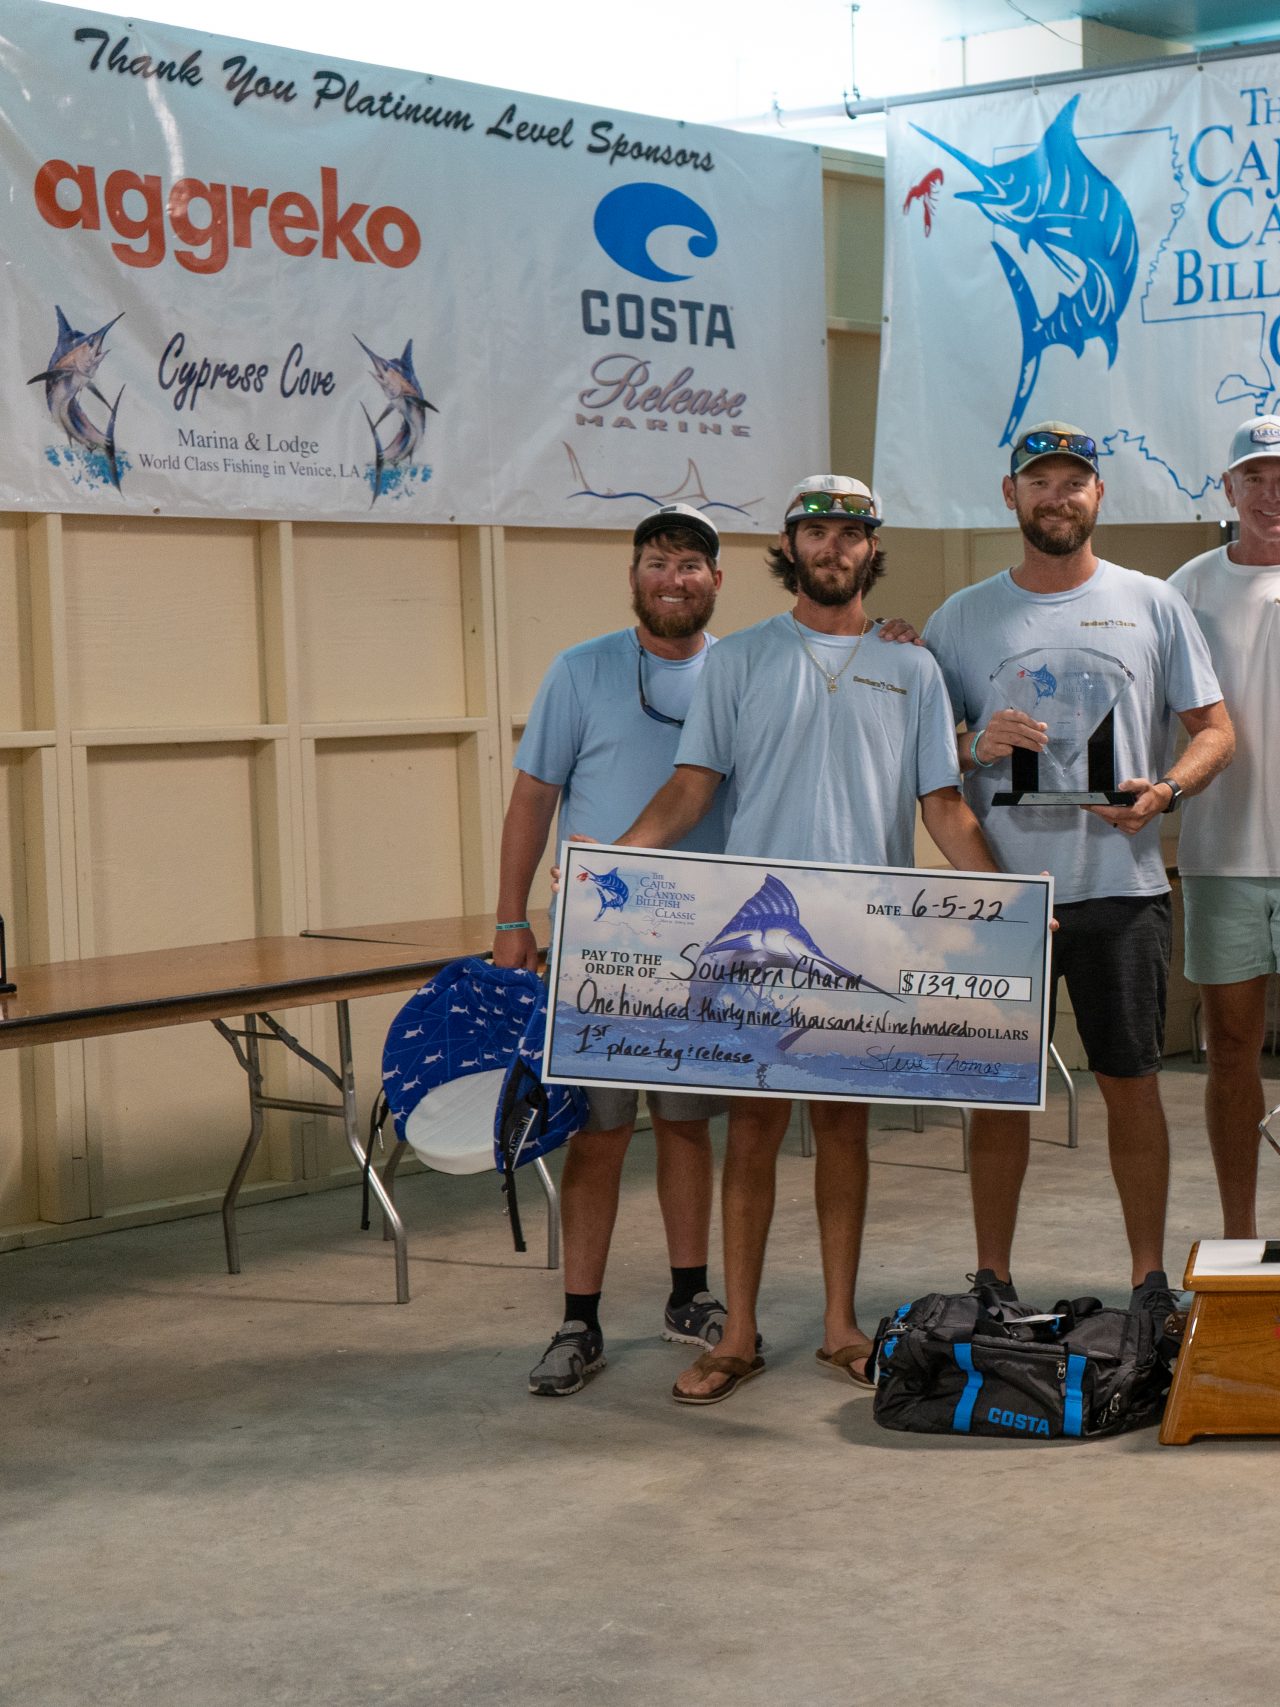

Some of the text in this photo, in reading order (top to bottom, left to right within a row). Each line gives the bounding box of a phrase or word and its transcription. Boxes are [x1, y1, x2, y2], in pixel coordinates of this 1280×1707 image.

[74, 27, 715, 172] Thank You Platinum Level Sponsors
[33, 158, 422, 275] aggreko
[581, 289, 736, 350] COSTA
[158, 332, 335, 411] Cypress Cove
[578, 353, 747, 418] Release
[576, 413, 752, 437] MARINE
[178, 429, 319, 458] Marina & Lodge
[139, 453, 360, 479] World Class Fishing in Venice, LA
[640, 877, 676, 890] CAJUN
[644, 888, 695, 901] CANYONS
[636, 895, 681, 908] BILLFISH
[655, 908, 696, 920] CLASSIC
[867, 904, 901, 916] DATE
[912, 889, 1004, 922] 6-5-22
[581, 949, 662, 965] PAY TO THE
[585, 963, 656, 978] ORDER OF
[670, 943, 863, 991] Southern Charm
[577, 978, 614, 1014] One
[619, 983, 690, 1020] hundred
[786, 1005, 864, 1033] thousand
[875, 1010, 908, 1034] Nine
[911, 1016, 967, 1038] hundred
[967, 1027, 1029, 1041] DOLLARS
[607, 1037, 649, 1061] place
[654, 1038, 683, 1070] tag
[694, 1043, 755, 1064] release
[928, 1052, 1002, 1075] Thomas
[987, 1407, 1050, 1436] COSTA
